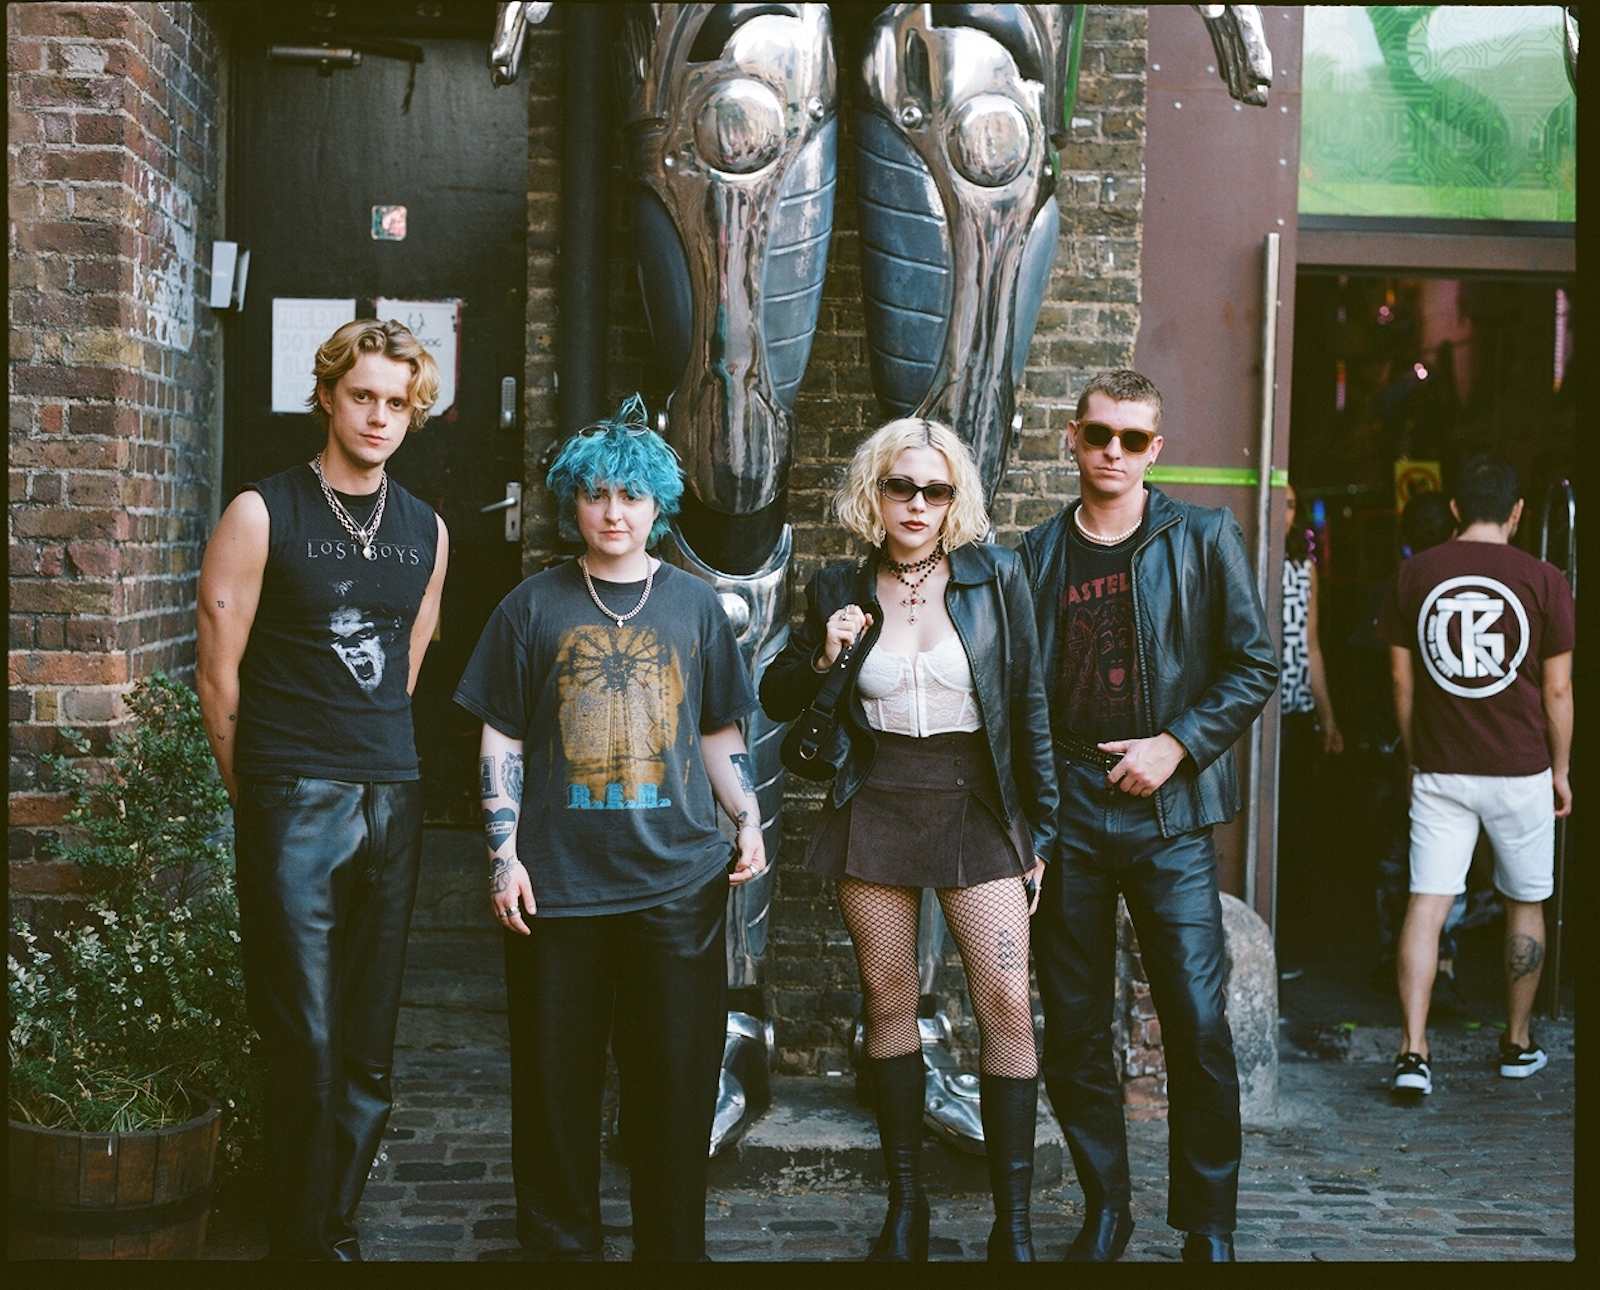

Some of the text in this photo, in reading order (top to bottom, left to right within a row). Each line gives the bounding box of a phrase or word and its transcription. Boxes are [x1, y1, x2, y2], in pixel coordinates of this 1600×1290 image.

[278, 307, 309, 327] FIRE
[279, 332, 303, 353] DO
[307, 541, 358, 560] LOST
